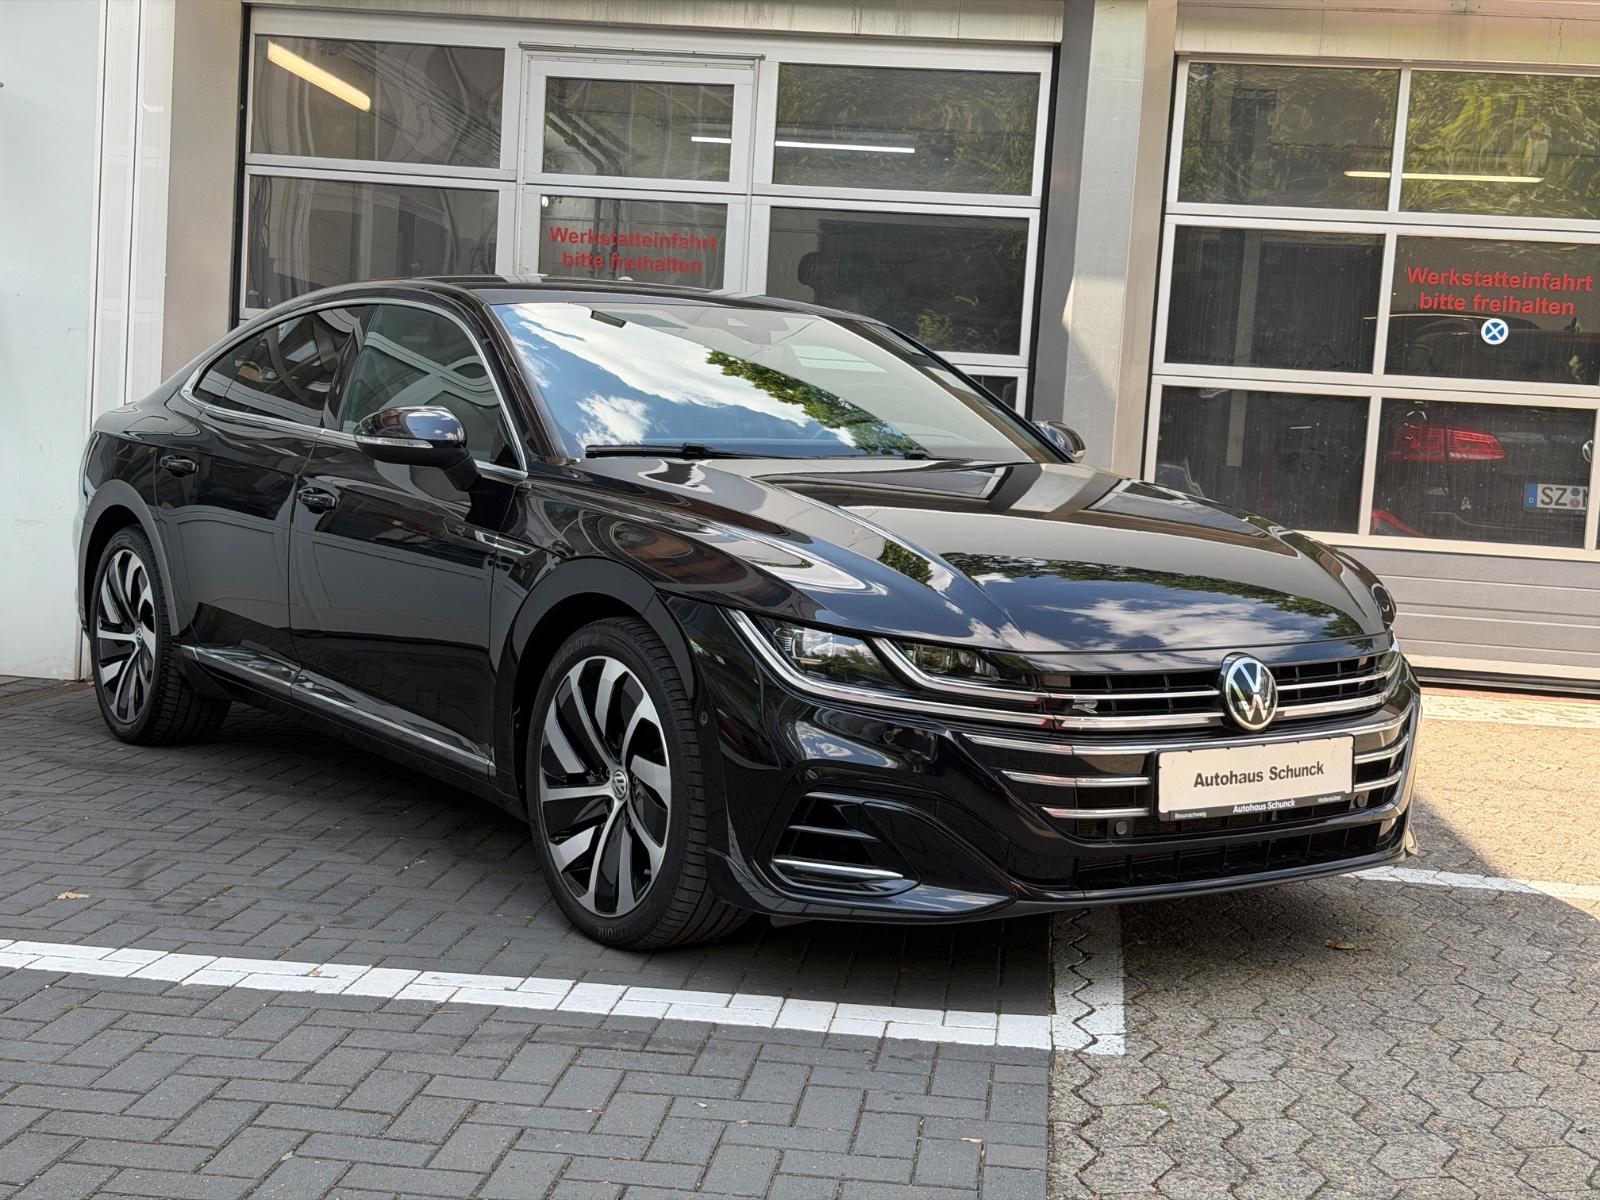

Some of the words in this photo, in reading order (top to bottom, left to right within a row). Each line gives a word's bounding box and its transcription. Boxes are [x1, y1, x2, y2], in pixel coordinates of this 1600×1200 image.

[548, 226, 717, 252] Werkstatteinfahrt
[561, 251, 605, 270] bitte
[610, 252, 702, 274] freihalten
[1407, 266, 1593, 292] Werkstatteinfahrt
[1419, 292, 1466, 311] bitte
[1473, 293, 1575, 316] freihalten
[1193, 770, 1264, 788] Autohaus
[1269, 761, 1325, 781] Schunck
[1233, 802, 1267, 814] Autohaus
[1267, 799, 1295, 811] Schunck
